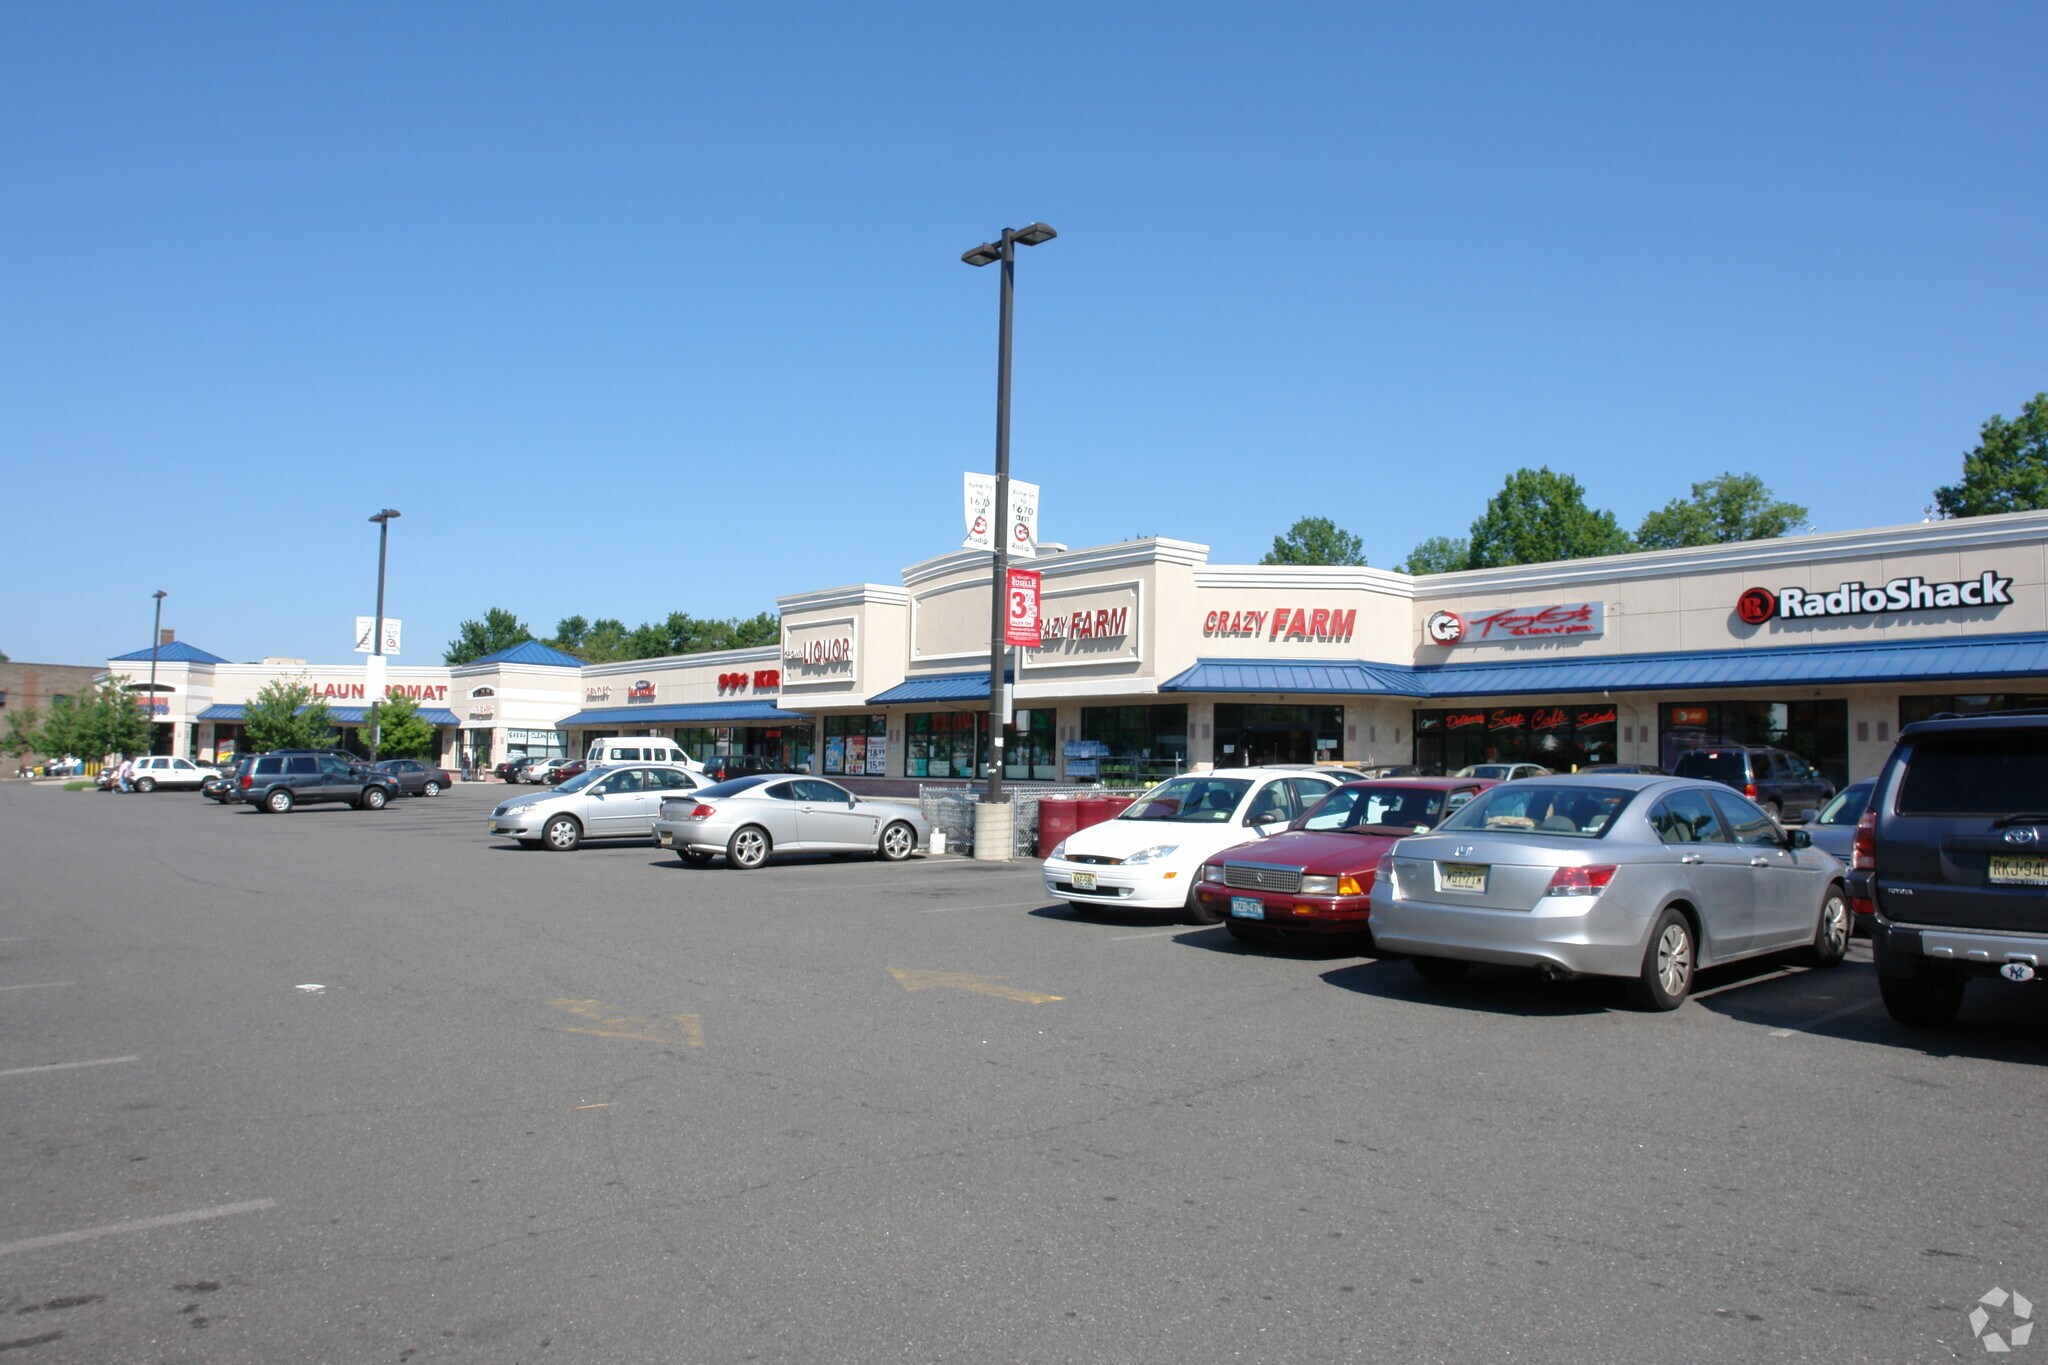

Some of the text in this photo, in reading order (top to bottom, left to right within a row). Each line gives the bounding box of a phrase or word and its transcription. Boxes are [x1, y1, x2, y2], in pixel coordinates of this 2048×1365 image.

[1012, 503, 1034, 516] 1670
[1015, 514, 1030, 522] am
[1011, 542, 1030, 552] Radio
[1011, 577, 1037, 588] ROSELLE
[1779, 571, 2010, 619] RadioShack
[1011, 591, 1027, 619] 3
[1040, 606, 1129, 640] RAZY FARM
[1205, 608, 1357, 637] CRAZY FARM
[803, 637, 850, 665] LIQUOR
[313, 682, 449, 701] LAUNROMAT
[1886, 886, 1914, 896] TOYOTA
